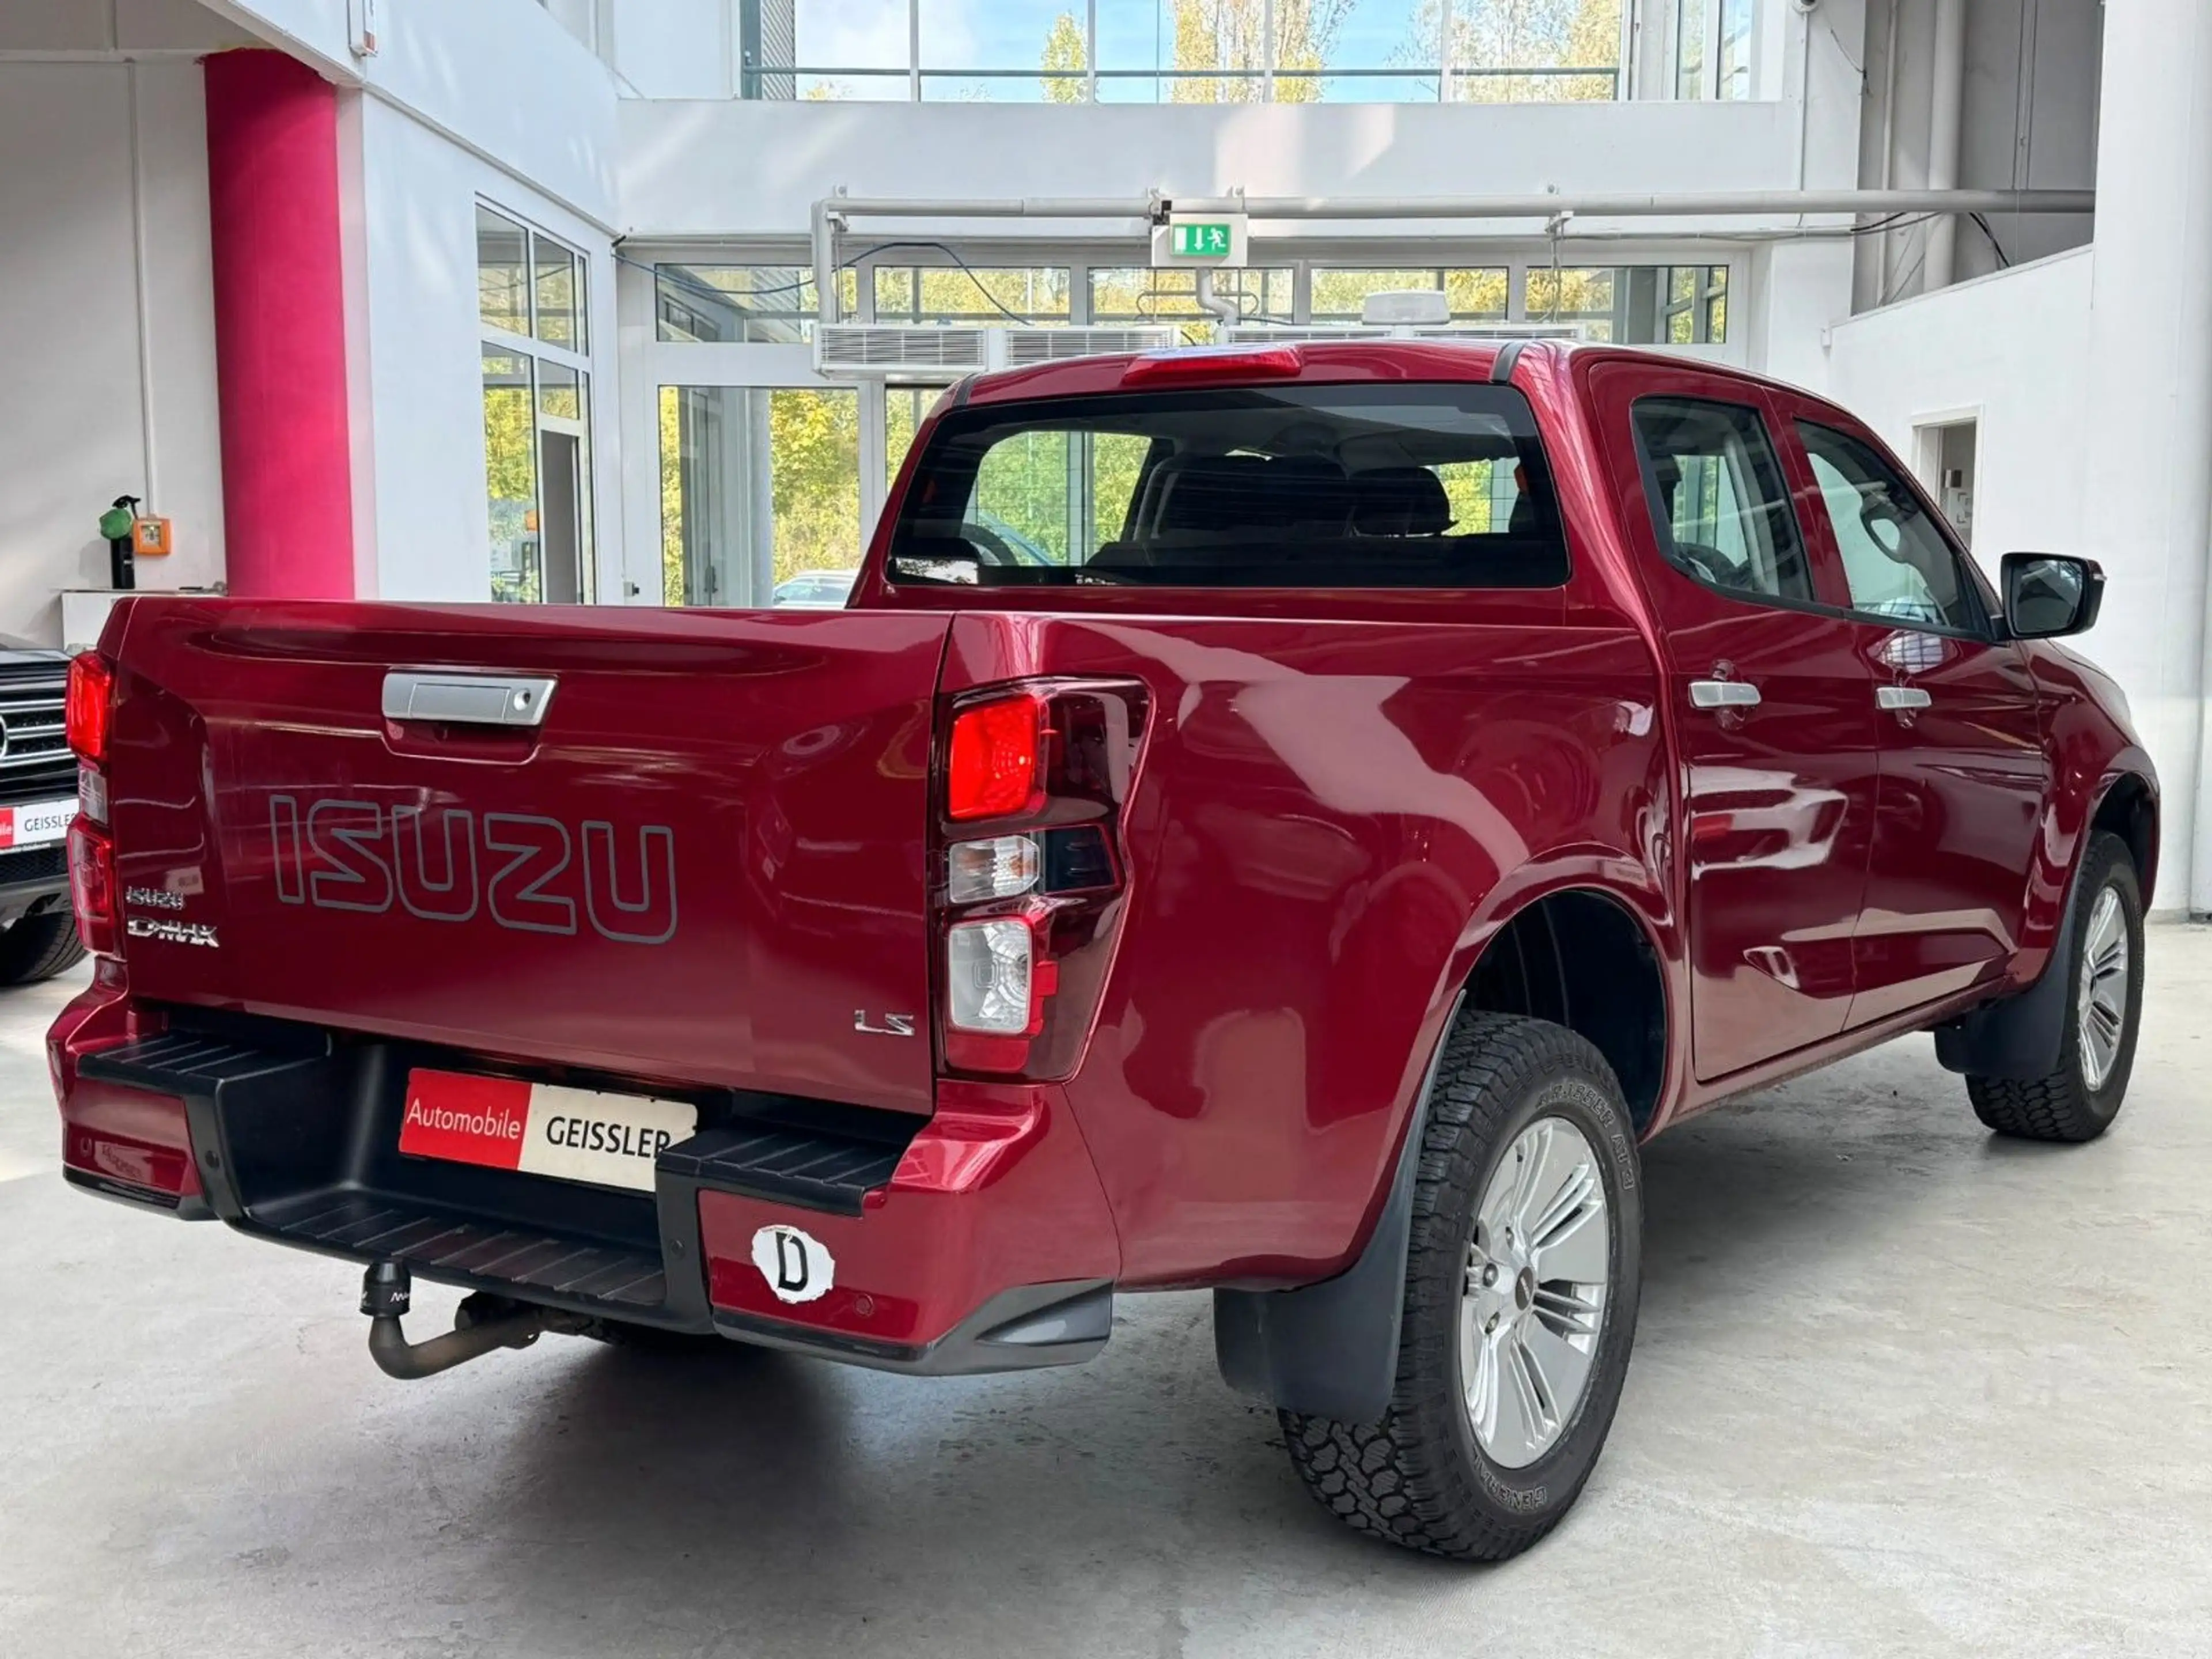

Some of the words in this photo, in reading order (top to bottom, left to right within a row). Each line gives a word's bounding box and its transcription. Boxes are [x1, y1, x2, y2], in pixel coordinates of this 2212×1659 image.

[24, 812, 75, 832] GEISSLE
[270, 794, 677, 944] ISUZU
[126, 885, 185, 911] ISUZU
[854, 1009, 915, 1036] LS
[406, 1097, 521, 1140] Automobile
[546, 1116, 671, 1159] GEISSLER
[775, 1232, 808, 1292] D
